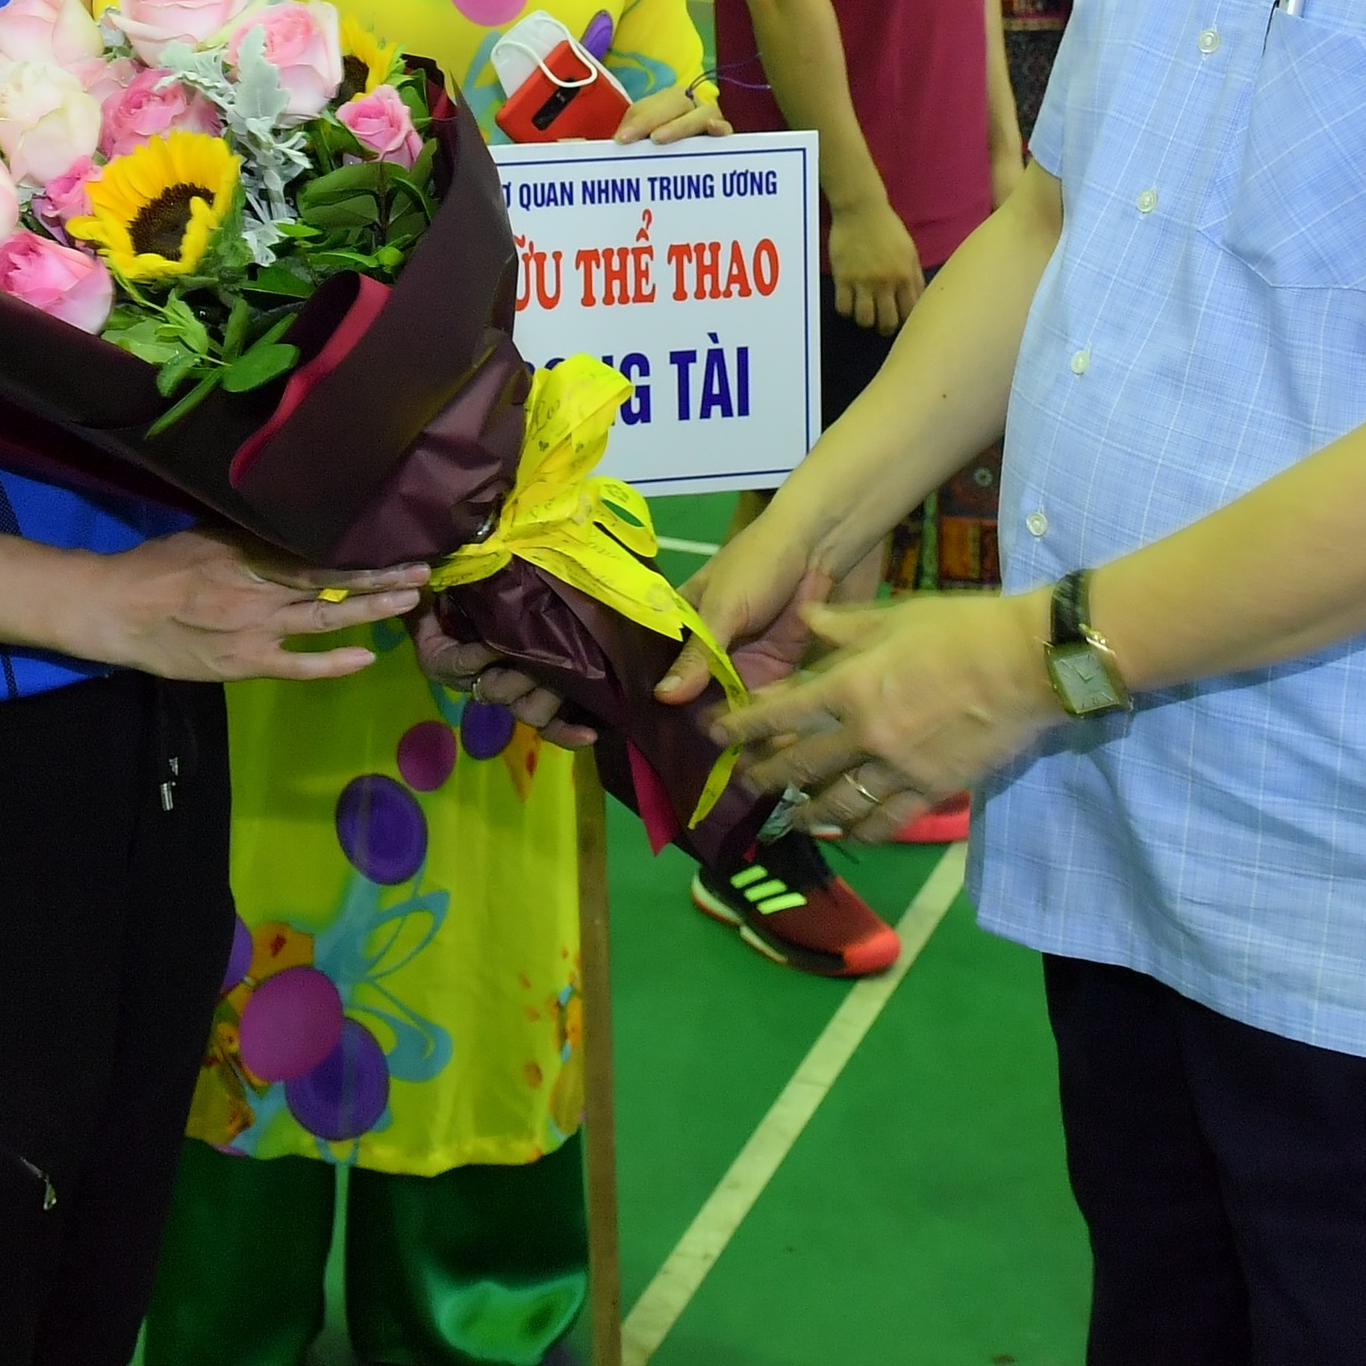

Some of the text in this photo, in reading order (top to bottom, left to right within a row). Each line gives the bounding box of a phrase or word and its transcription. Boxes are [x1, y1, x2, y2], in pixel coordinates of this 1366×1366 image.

[519, 181, 574, 212] QUAN
[582, 177, 640, 206] NHNN
[647, 173, 715, 202] TRUNG
[722, 168, 777, 198] ƯƠNG
[575, 207, 656, 308] THỂ
[667, 238, 780, 302] THAO
[668, 331, 750, 422] TÀI
